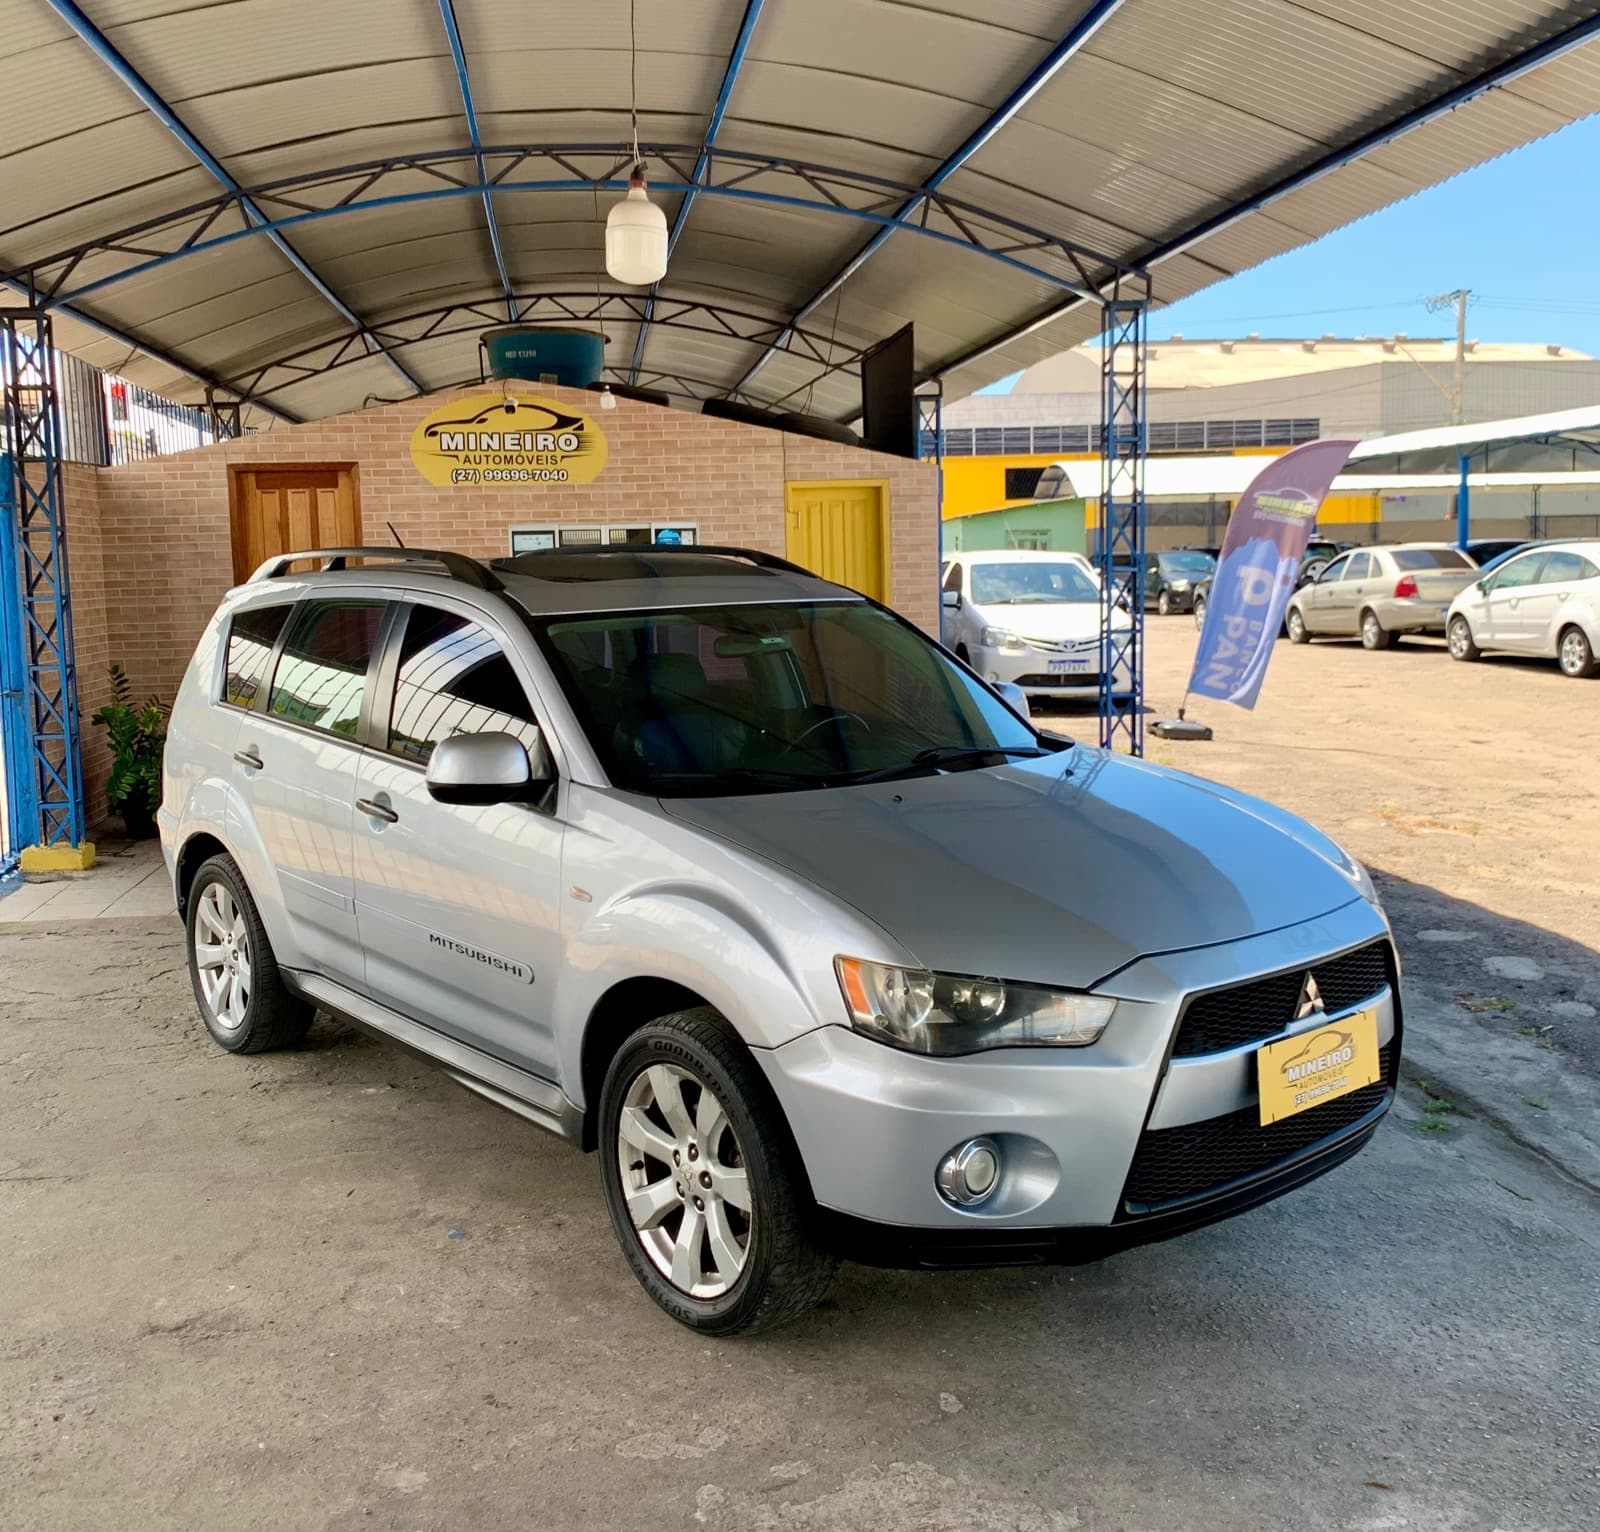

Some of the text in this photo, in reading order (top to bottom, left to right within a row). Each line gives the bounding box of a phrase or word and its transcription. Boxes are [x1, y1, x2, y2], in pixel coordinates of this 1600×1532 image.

[440, 432, 580, 451] MINEIRO
[463, 453, 558, 465] AUTOMÓVEIS
[452, 469, 568, 484] (27) 99696-7040
[1203, 614, 1247, 690] PAN
[429, 933, 522, 977] MITSUBISHI
[1287, 1046, 1352, 1083] MINEIRO
